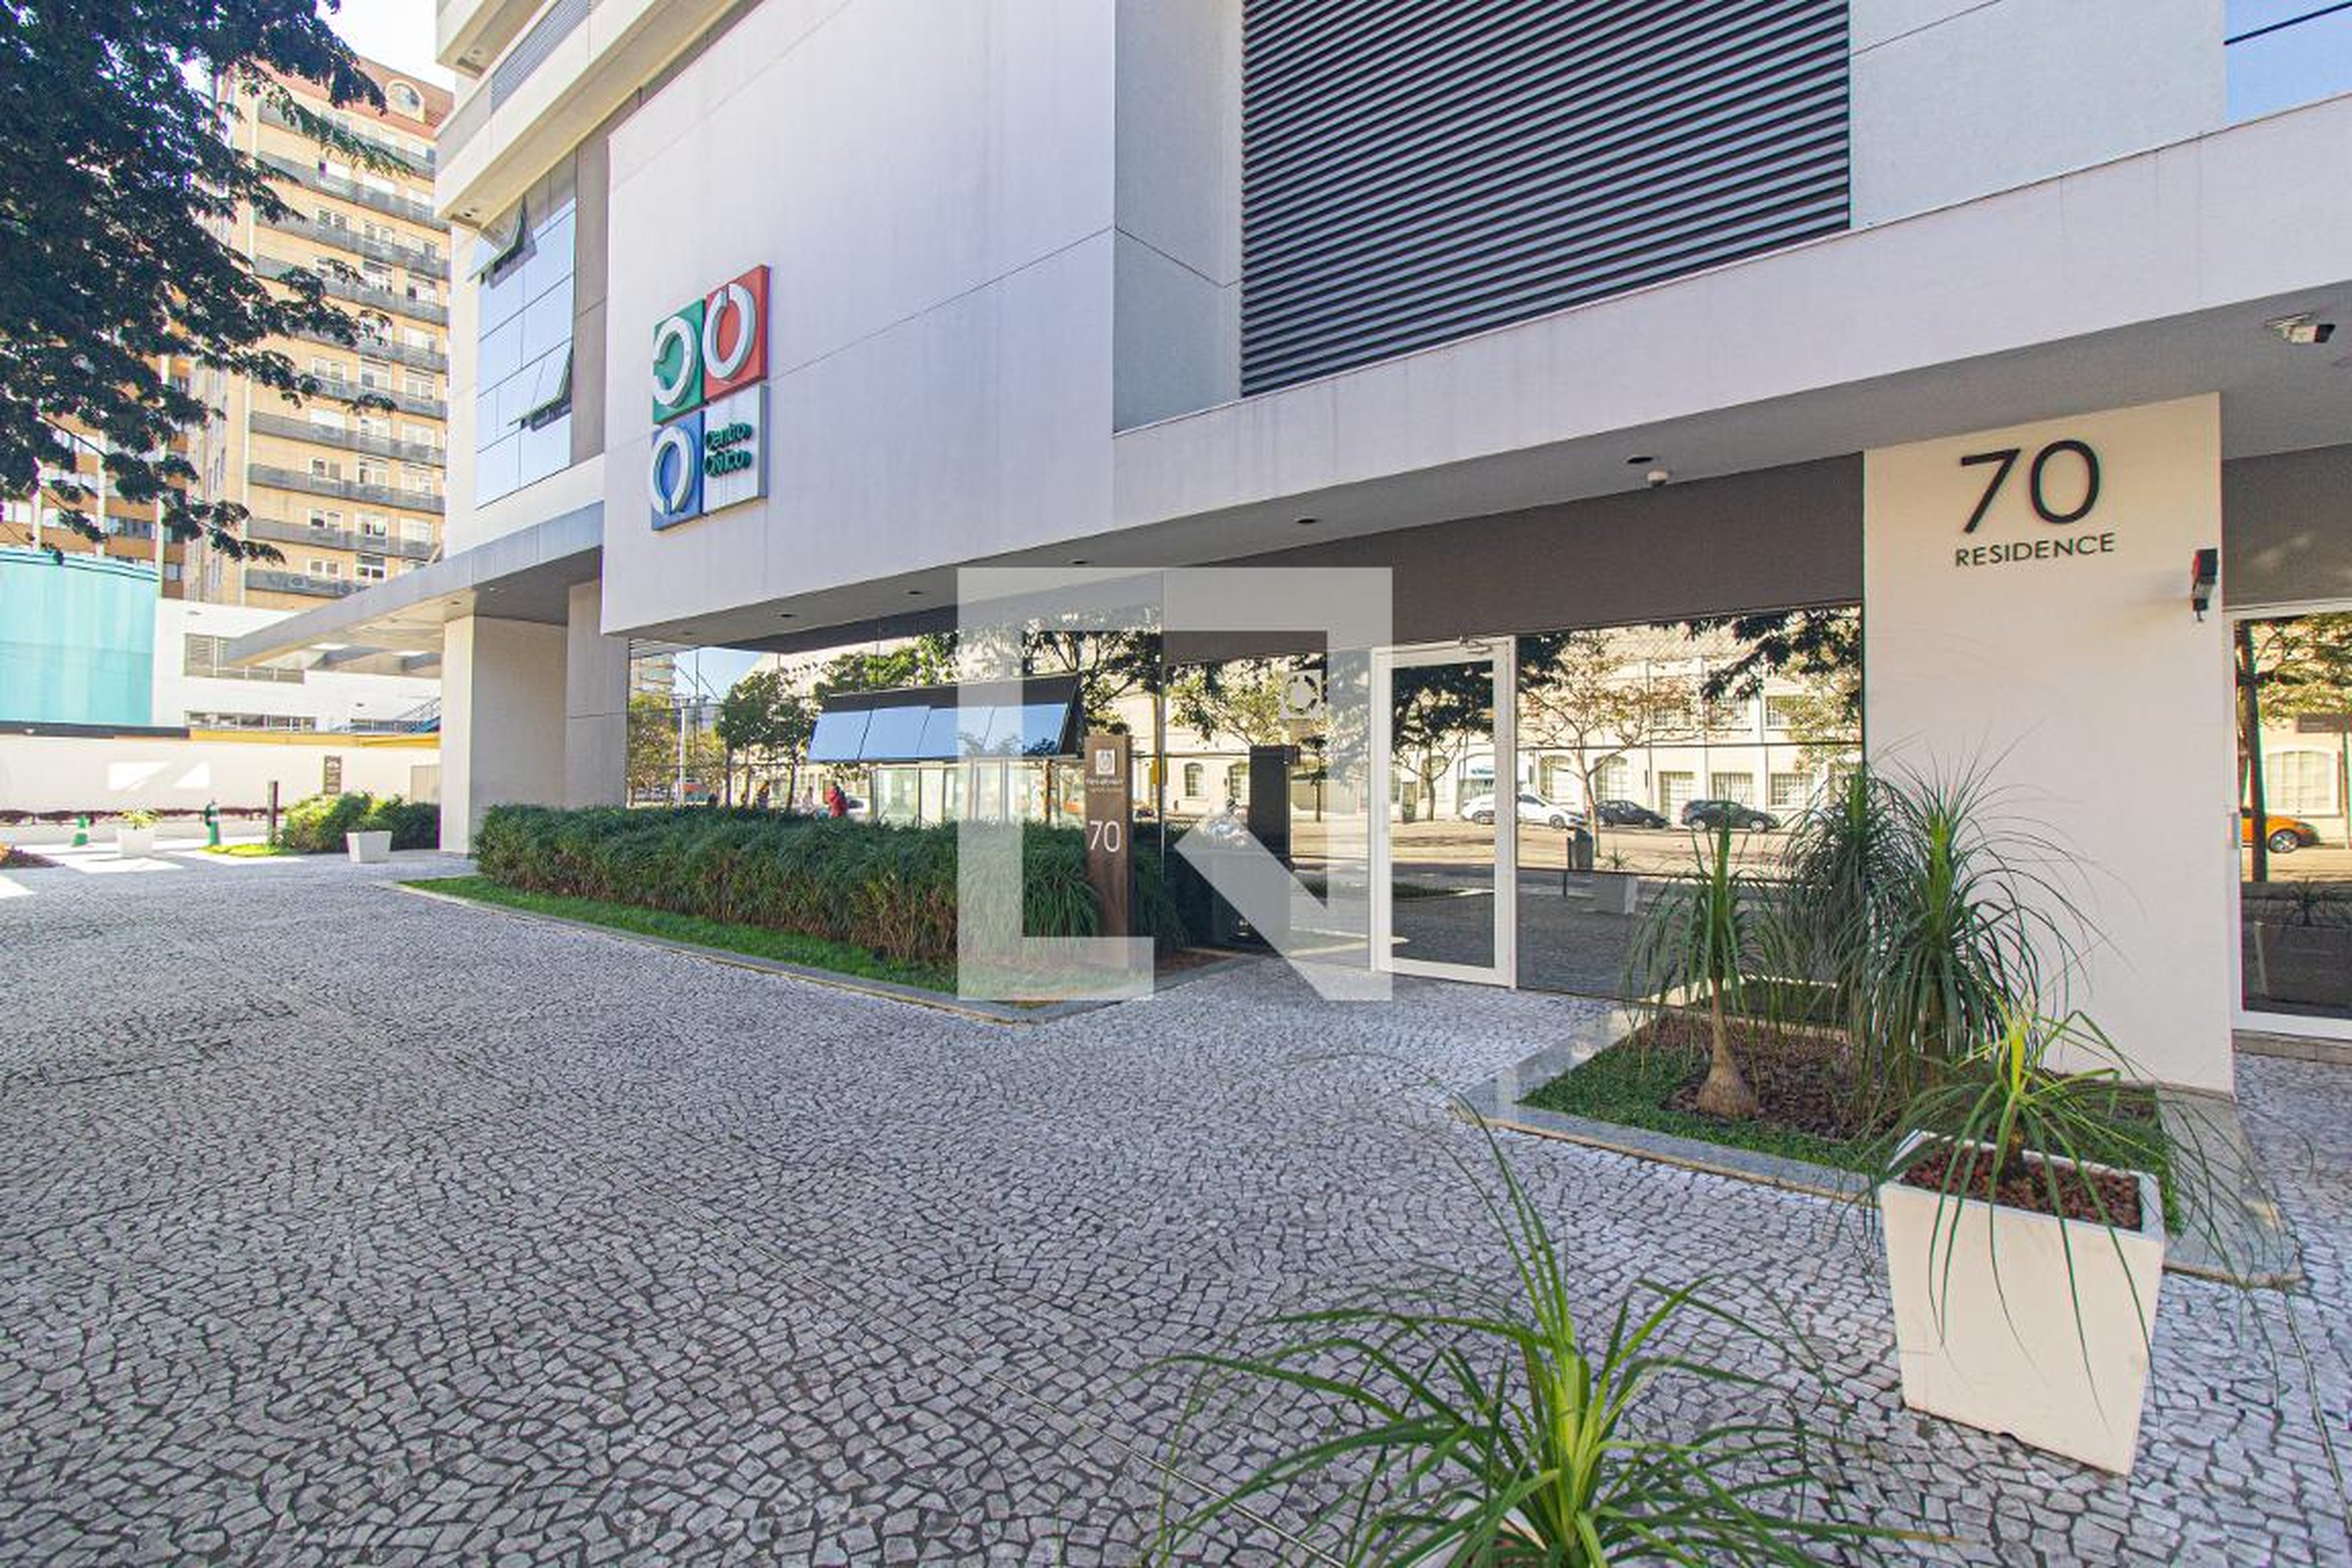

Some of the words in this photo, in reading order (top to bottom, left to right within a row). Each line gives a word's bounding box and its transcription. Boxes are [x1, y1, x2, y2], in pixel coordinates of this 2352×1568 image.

[1960, 440, 2100, 534] 70
[1955, 532, 2115, 567] RESIDENCE
[1090, 820, 1121, 852] 70
